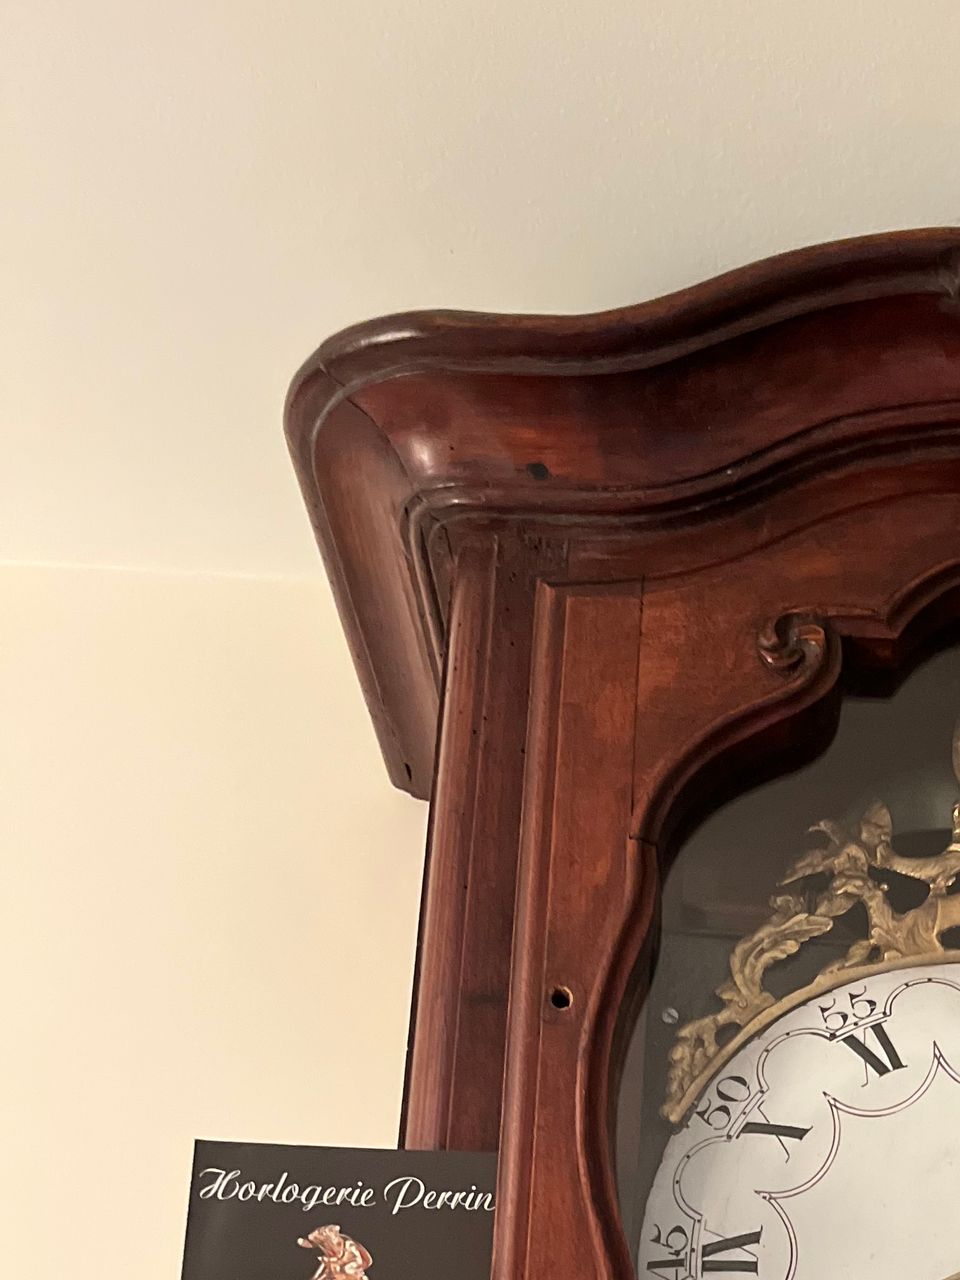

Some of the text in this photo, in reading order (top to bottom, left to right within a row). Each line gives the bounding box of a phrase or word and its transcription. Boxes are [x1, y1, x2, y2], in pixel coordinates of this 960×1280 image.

[818, 985, 877, 1031] 55
[696, 1075, 751, 1131] 50
[736, 1101, 813, 1163] X
[199, 1168, 496, 1215] Horlogerie Perrin
